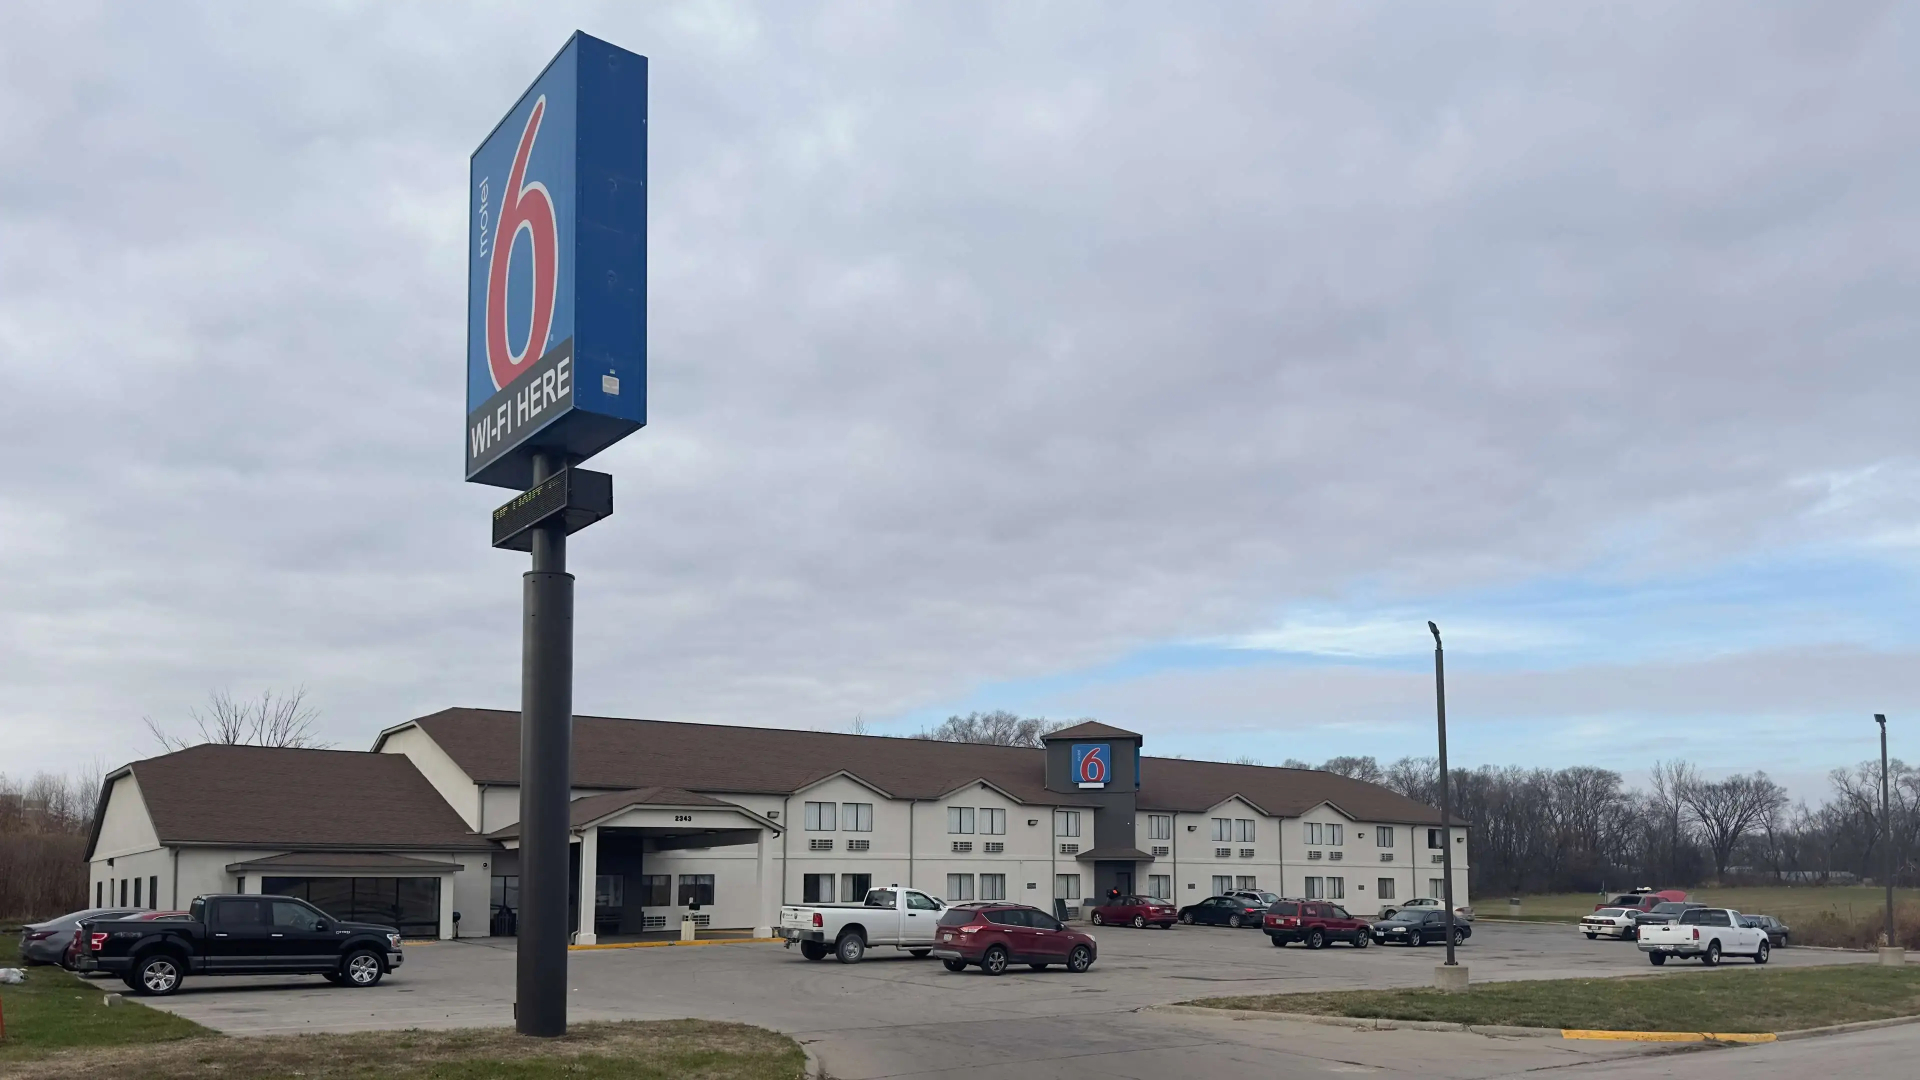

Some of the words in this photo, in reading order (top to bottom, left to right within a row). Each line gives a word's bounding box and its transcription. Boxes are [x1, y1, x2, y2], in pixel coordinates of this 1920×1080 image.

[479, 176, 489, 258] motel
[485, 93, 559, 393] 6
[471, 399, 512, 459] WI-FI
[517, 356, 570, 428] HERE
[1080, 747, 1106, 782] 6
